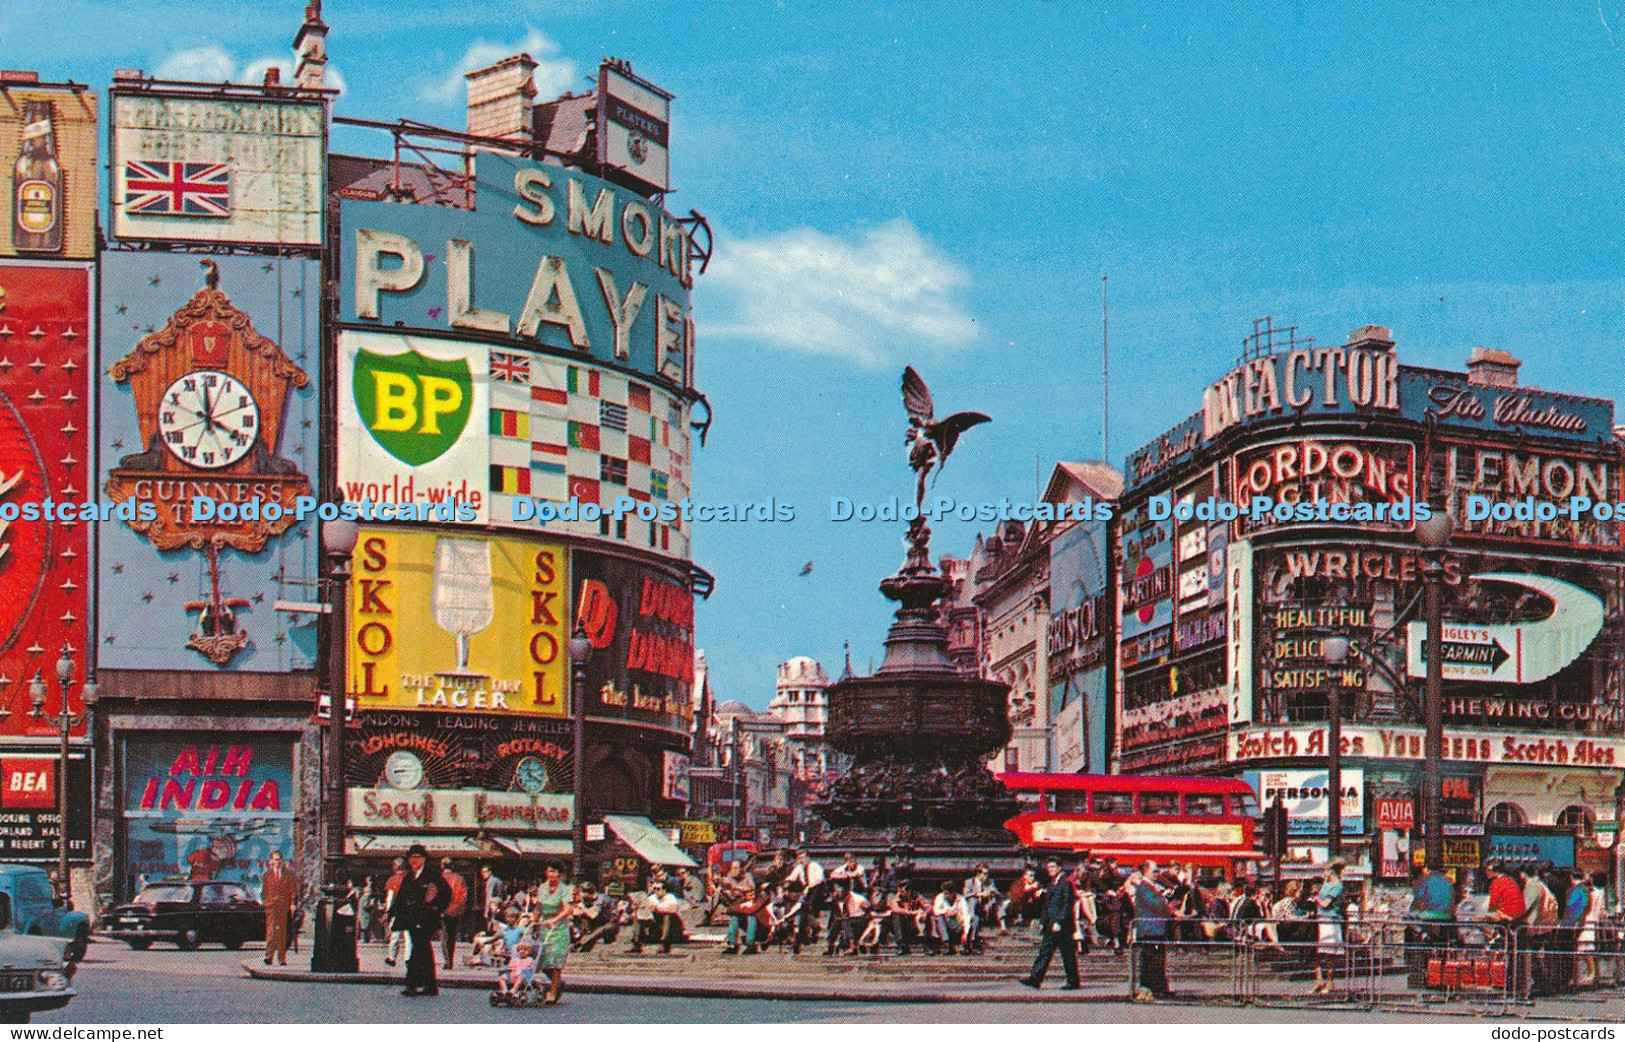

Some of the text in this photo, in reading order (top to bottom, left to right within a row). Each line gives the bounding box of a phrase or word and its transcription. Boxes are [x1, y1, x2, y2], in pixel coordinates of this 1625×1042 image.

[355, 227, 694, 393] PLAYE
[370, 370, 463, 435] BP
[1446, 447, 1608, 503] LEMON
[134, 479, 283, 503] GUINNESS
[358, 537, 392, 697] SKOL
[1276, 607, 1368, 629] HEALTHFUL
[530, 551, 560, 706] SKOL
[1443, 627, 1490, 641] IGLEY'S
[1274, 639, 1359, 660] DELICIS
[1440, 644, 1498, 663] EARMINT
[1272, 669, 1364, 689] SATISFNG
[1443, 665, 1465, 675] WING
[402, 674, 437, 690] THE
[416, 690, 512, 711] LAGER
[1441, 699, 1550, 719] HEWING
[357, 713, 420, 728] ONDONS
[436, 716, 498, 731] LEADING
[359, 733, 449, 758] LONGINES
[497, 738, 568, 761] ROTARY
[1236, 731, 1298, 758] Scotch
[1305, 730, 1365, 755] Aes
[1501, 735, 1568, 764] Scotch
[1572, 740, 1615, 765] Ales
[168, 743, 255, 778] AIR
[9, 771, 48, 792] BEA
[140, 778, 281, 811] INDIA
[37, 814, 62, 823] OFFIC
[475, 793, 570, 823] Lawrence
[1380, 801, 1414, 820] AVIA
[41, 827, 62, 837] HAL
[51, 840, 87, 850] STEET
